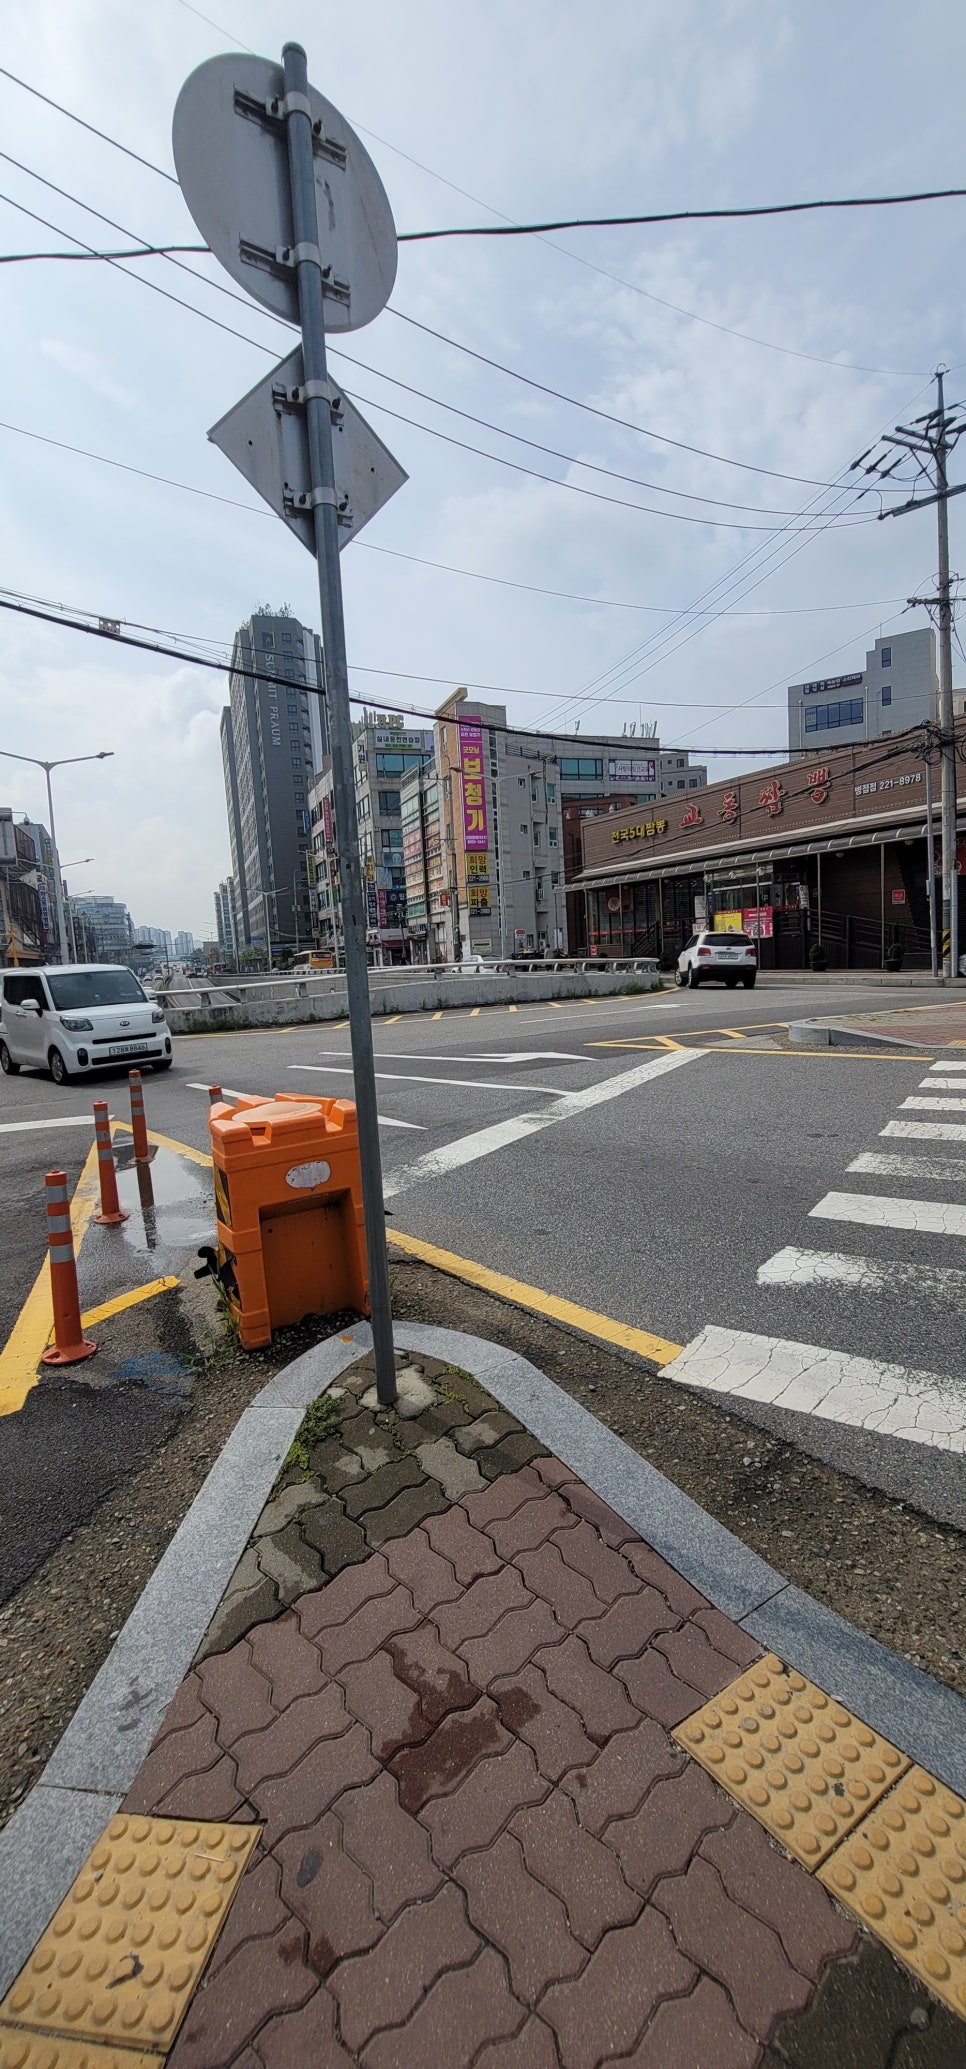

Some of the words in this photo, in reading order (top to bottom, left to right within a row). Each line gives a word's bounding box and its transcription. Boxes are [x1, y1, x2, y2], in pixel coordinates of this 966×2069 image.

[269, 707, 281, 746] PRAUM
[854, 781, 877, 796] 병점점
[879, 773, 922, 791] 221-8978
[463, 757, 485, 832] 보청기
[469, 855, 486, 865] 희망
[469, 864, 487, 875] 인력
[470, 887, 488, 898] 희망
